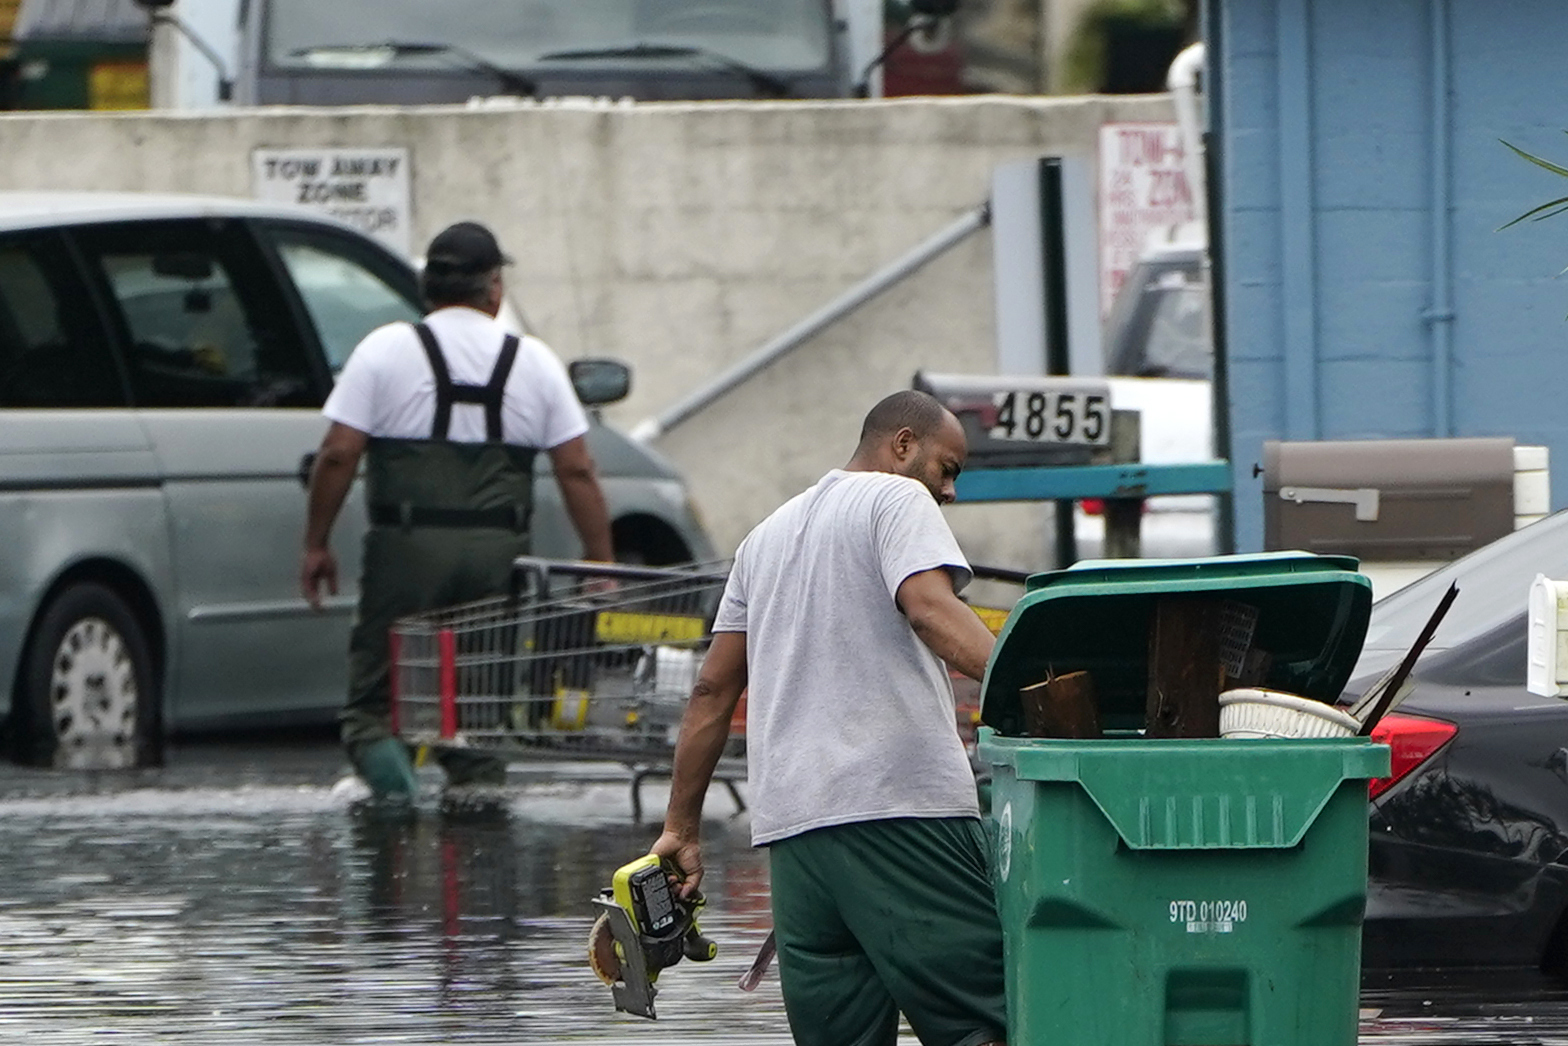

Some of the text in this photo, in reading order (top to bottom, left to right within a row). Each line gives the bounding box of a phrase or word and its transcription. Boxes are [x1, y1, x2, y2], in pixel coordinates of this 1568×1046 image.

[265, 156, 400, 180] TOW AWAY
[298, 181, 368, 204] ZONE
[996, 391, 1104, 440] 4855
[1169, 900, 1247, 922] 9TD 010240
